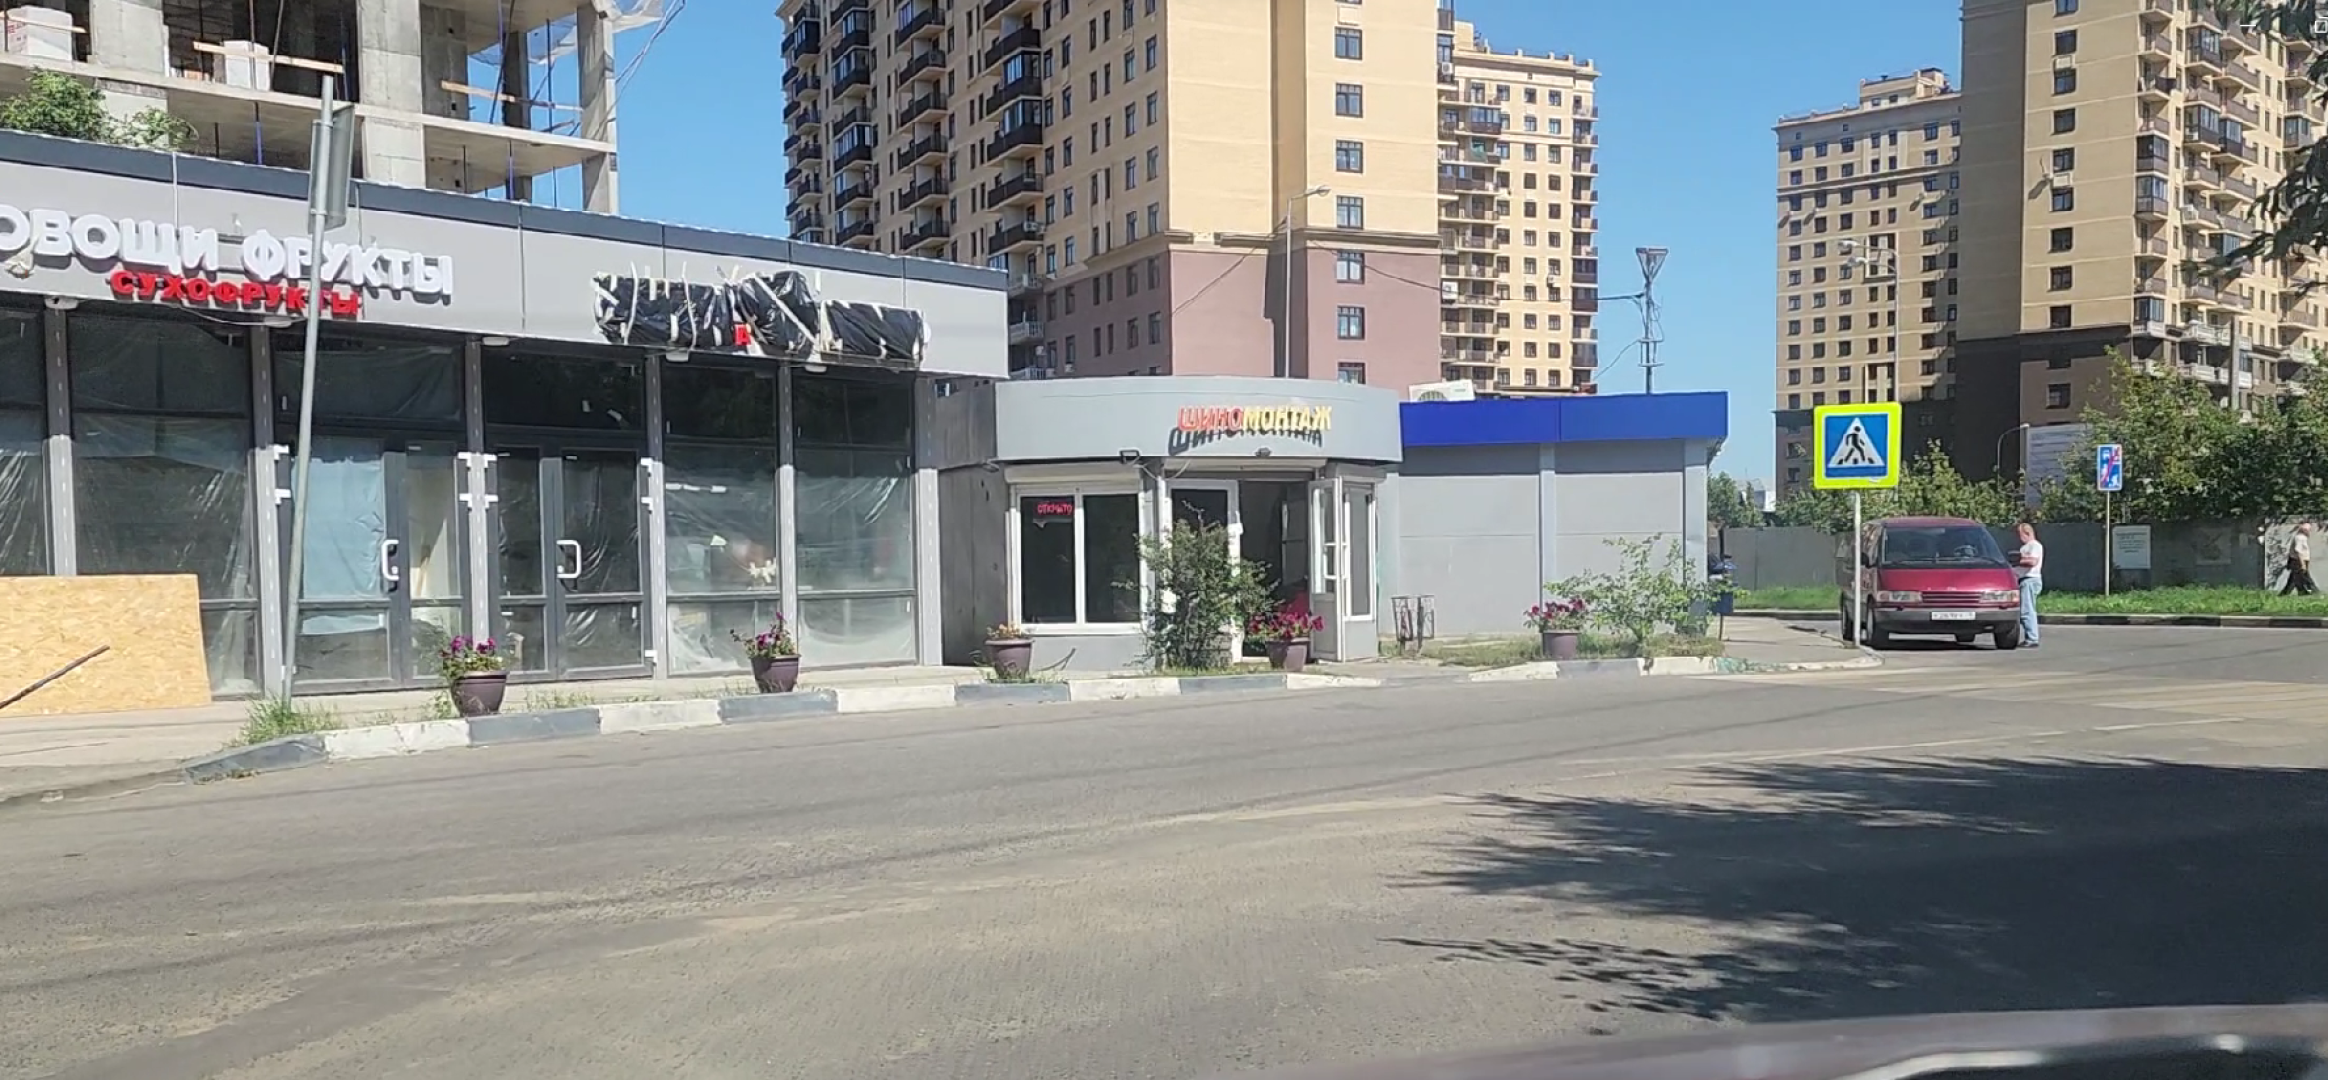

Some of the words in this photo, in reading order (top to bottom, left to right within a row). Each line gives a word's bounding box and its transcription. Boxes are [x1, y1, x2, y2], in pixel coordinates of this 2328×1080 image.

[0, 206, 218, 274] ОВОЩИ
[242, 229, 453, 294] ФРУКТЫ
[110, 269, 359, 314] СУХОФРУКТЫ
[1178, 406, 1332, 431] ШИНОМОНТАЖ
